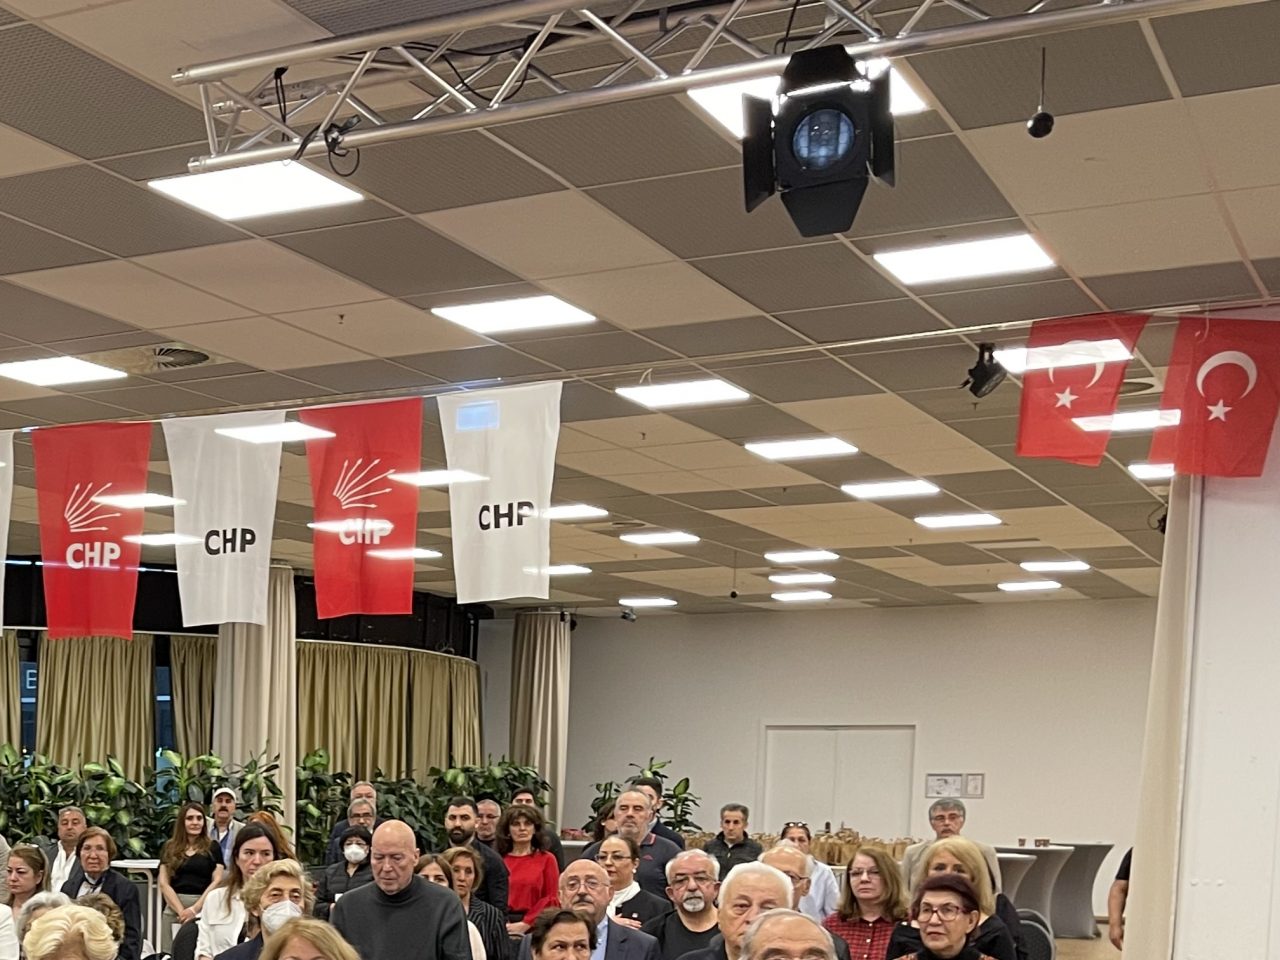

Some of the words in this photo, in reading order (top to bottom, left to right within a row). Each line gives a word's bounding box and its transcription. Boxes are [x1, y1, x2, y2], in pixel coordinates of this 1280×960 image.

[478, 501, 534, 530] CHP
[205, 529, 255, 554] CHP
[66, 543, 120, 568] CHP
